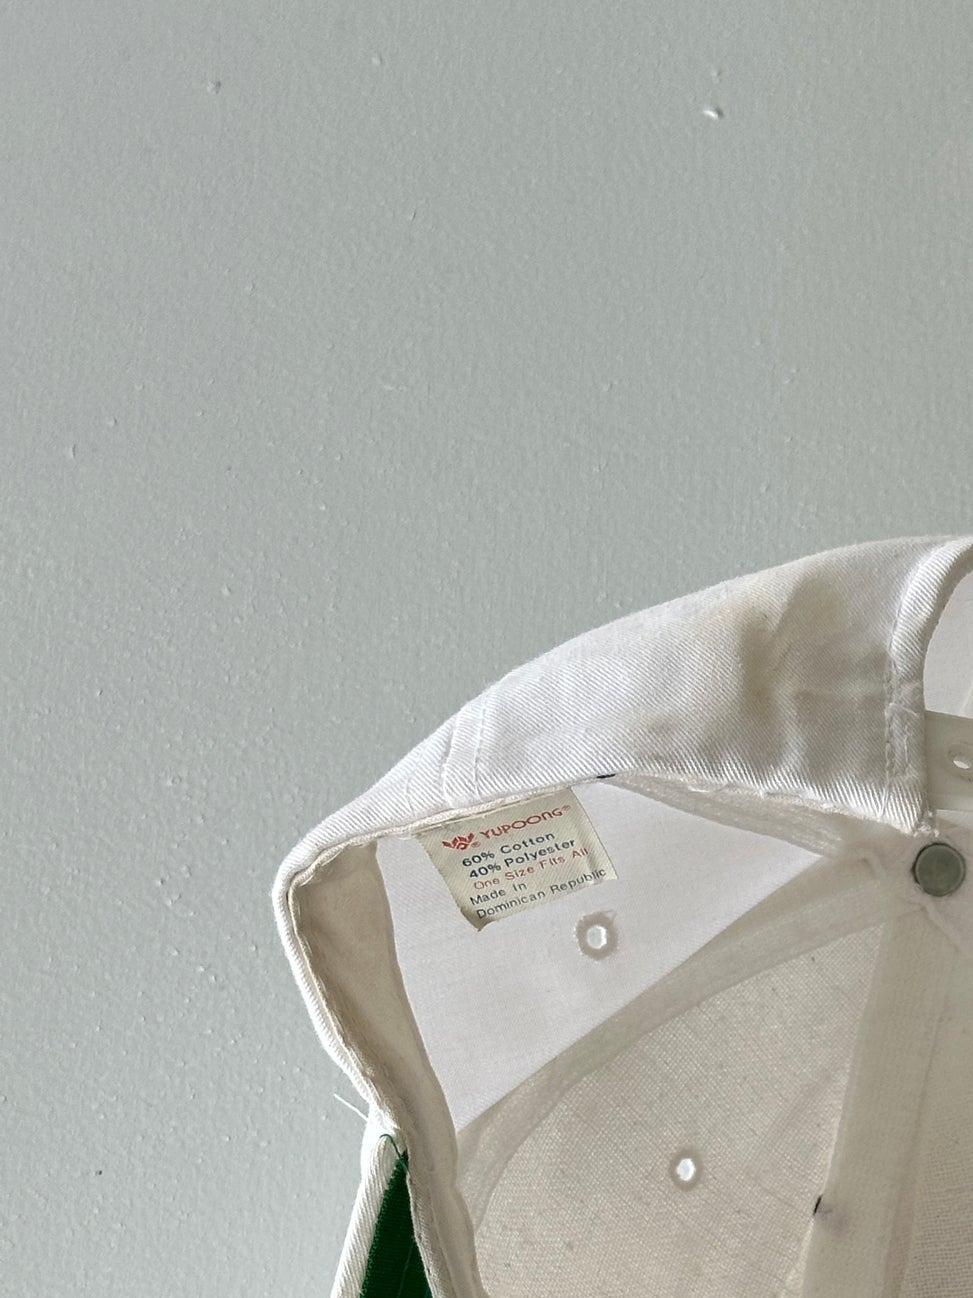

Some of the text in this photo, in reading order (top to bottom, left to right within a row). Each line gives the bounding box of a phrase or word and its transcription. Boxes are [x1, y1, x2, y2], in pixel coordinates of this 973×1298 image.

[479, 808, 563, 839] YUPOONG
[462, 832, 556, 868] 60% Cotton
[469, 838, 576, 879] 40% Polyester
[473, 848, 588, 890] One Size Fits All
[469, 881, 528, 906] Made In
[477, 867, 607, 919] Dominican Republic
